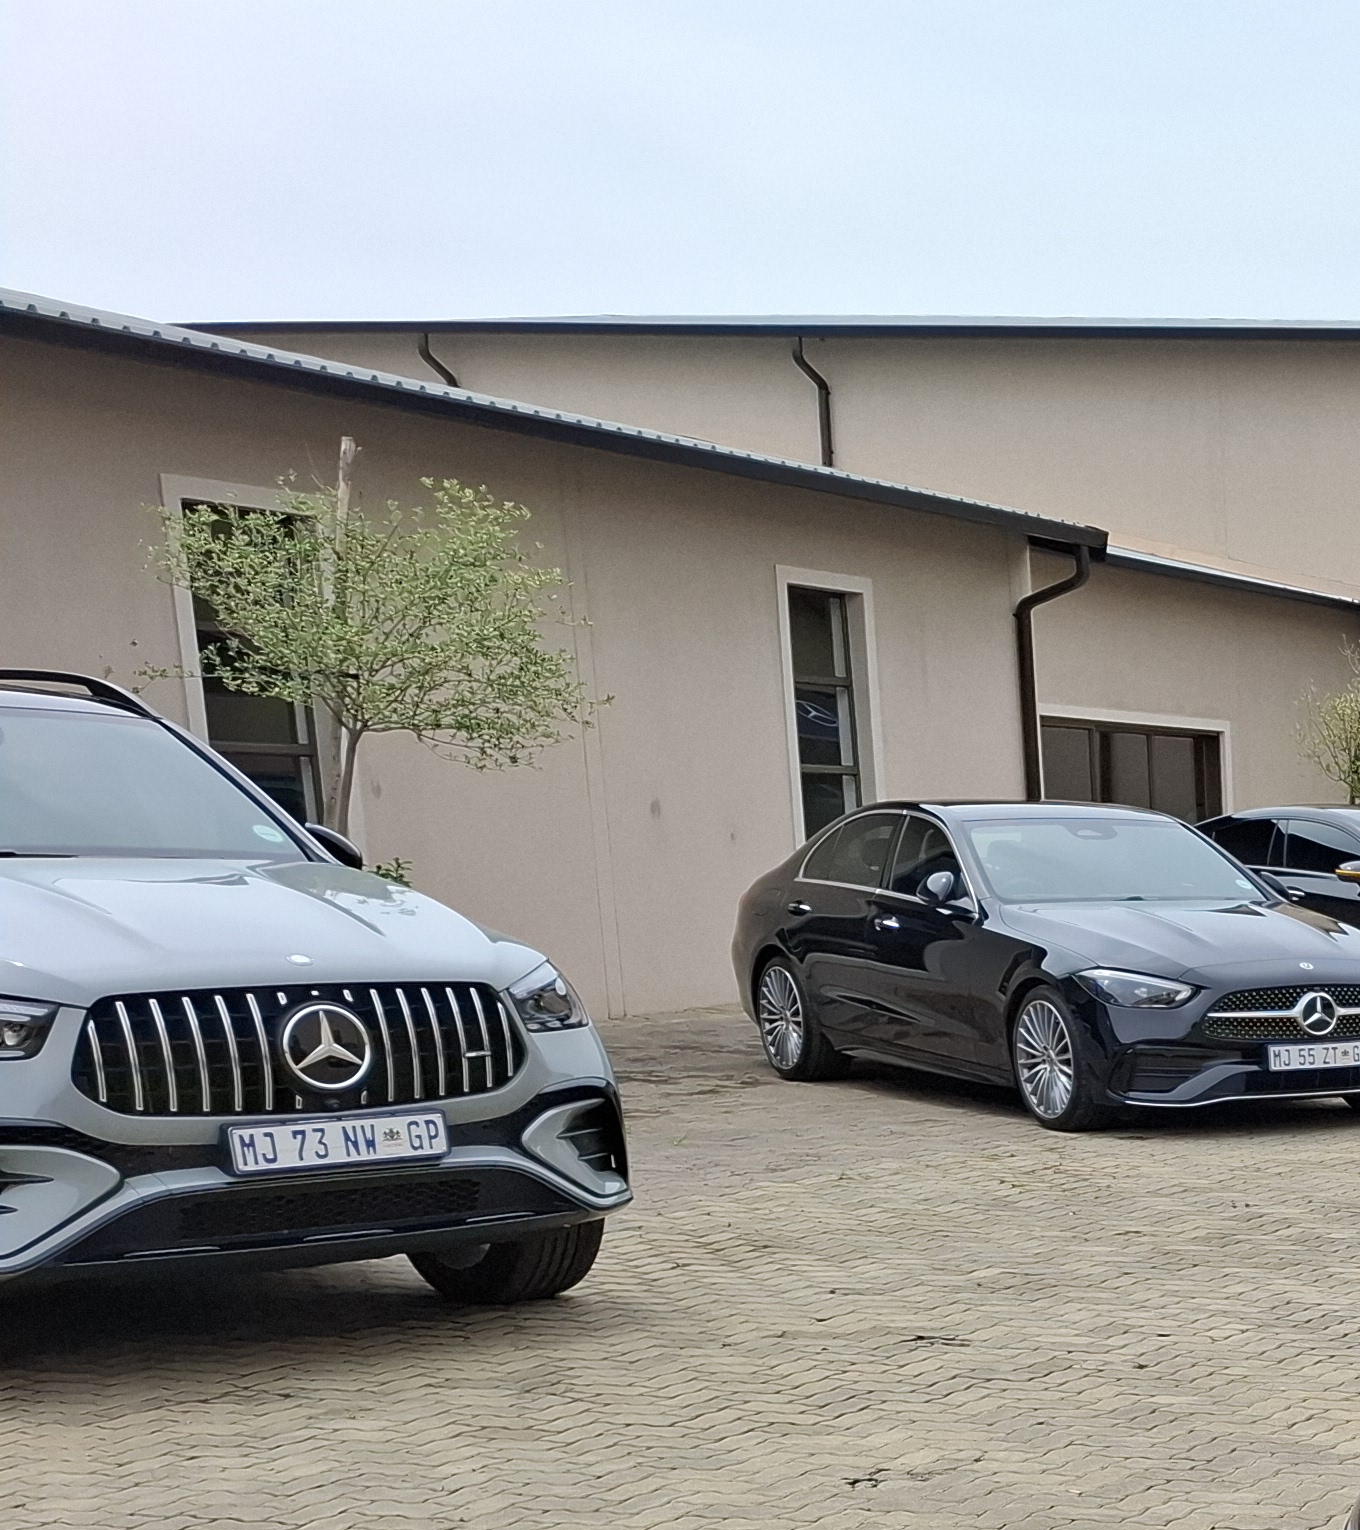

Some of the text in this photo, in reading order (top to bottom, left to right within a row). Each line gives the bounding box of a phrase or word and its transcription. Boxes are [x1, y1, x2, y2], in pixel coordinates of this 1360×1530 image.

[1272, 1049, 1291, 1068] MJ
[1298, 1047, 1316, 1066] 55
[1321, 1046, 1339, 1065] ZT
[238, 1118, 439, 1167] MJ 73 NW GP
